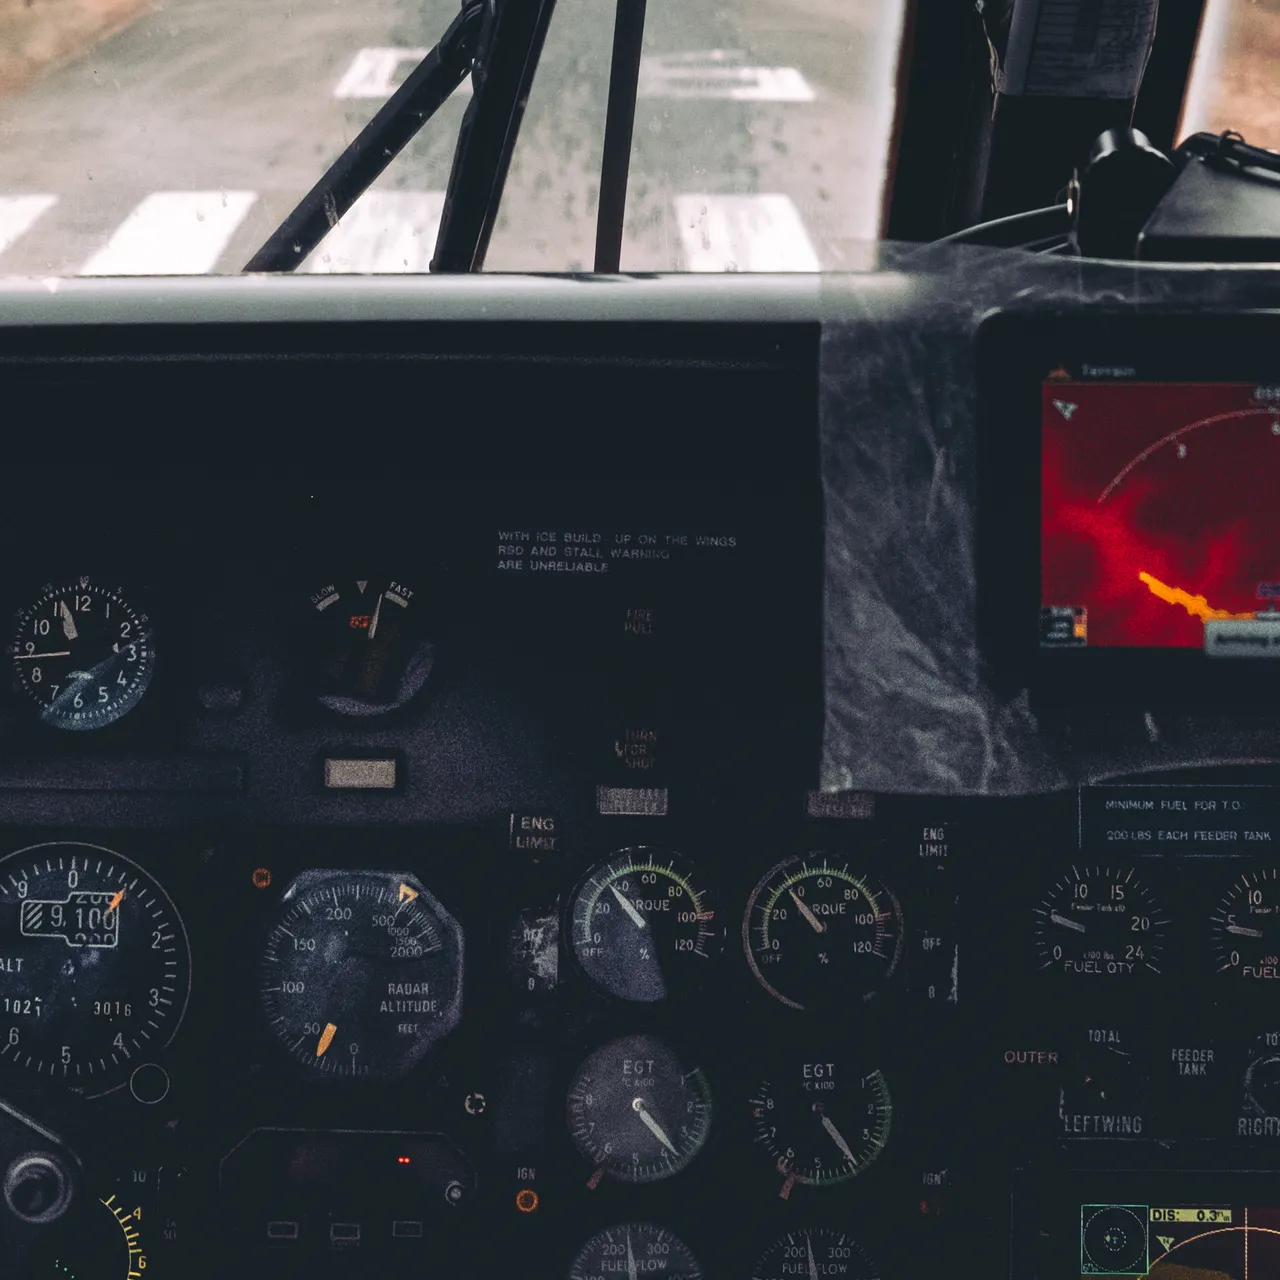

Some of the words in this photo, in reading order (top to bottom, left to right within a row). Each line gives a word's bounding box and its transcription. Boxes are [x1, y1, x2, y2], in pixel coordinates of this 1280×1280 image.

[389, 580, 415, 600] FAST
[74, 594, 92, 612] 12
[33, 618, 51, 636] 10
[119, 621, 132, 639] 2
[126, 644, 138, 662] 3
[30, 666, 43, 684] 8
[97, 685, 110, 703] 5
[1160, 799, 1189, 811] FUEL
[1193, 799, 1217, 811] FOR
[520, 816, 556, 832] ENG
[922, 826, 945, 842] ENG
[67, 869, 79, 889] 0
[640, 872, 658, 885] 60
[816, 876, 833, 889] 60
[17, 880, 29, 899] 9
[667, 885, 684, 898] 80
[843, 888, 860, 901] 80
[1073, 883, 1089, 900] 10
[1109, 884, 1125, 901] 15
[1247, 888, 1264, 906] 10
[594, 902, 611, 915] 20
[622, 898, 671, 912] ORQUE
[325, 907, 353, 922] 200
[371, 914, 396, 929] 500
[677, 912, 697, 924] 100
[772, 908, 788, 921] 20
[854, 913, 874, 926] 100
[1130, 915, 1151, 932] 20
[150, 930, 163, 950] 2
[292, 938, 317, 952] 150
[674, 939, 695, 952] 120
[852, 941, 873, 954] 120
[390, 945, 424, 959] 2000
[1123, 943, 1145, 961] 24
[1063, 959, 1103, 974] FUEL
[1106, 960, 1135, 975] QTY
[281, 981, 305, 995] 100
[387, 981, 430, 996] RADAR
[148, 987, 160, 1008] 3
[379, 999, 438, 1014] ALTITUDE
[303, 1022, 321, 1036] 50
[1087, 1028, 1122, 1044] TOTAL
[1003, 1049, 1060, 1065] OUTER
[1170, 1048, 1215, 1063] FEEDER
[621, 1058, 656, 1075] EGT
[802, 1062, 835, 1079] EGT
[1178, 1062, 1207, 1076] TANK
[516, 1166, 536, 1181] IGN
[1152, 1209, 1181, 1222] DIS:
[601, 1243, 626, 1256] 200
[646, 1242, 670, 1256] 300
[783, 1246, 807, 1259] 200
[826, 1246, 852, 1260] 300
